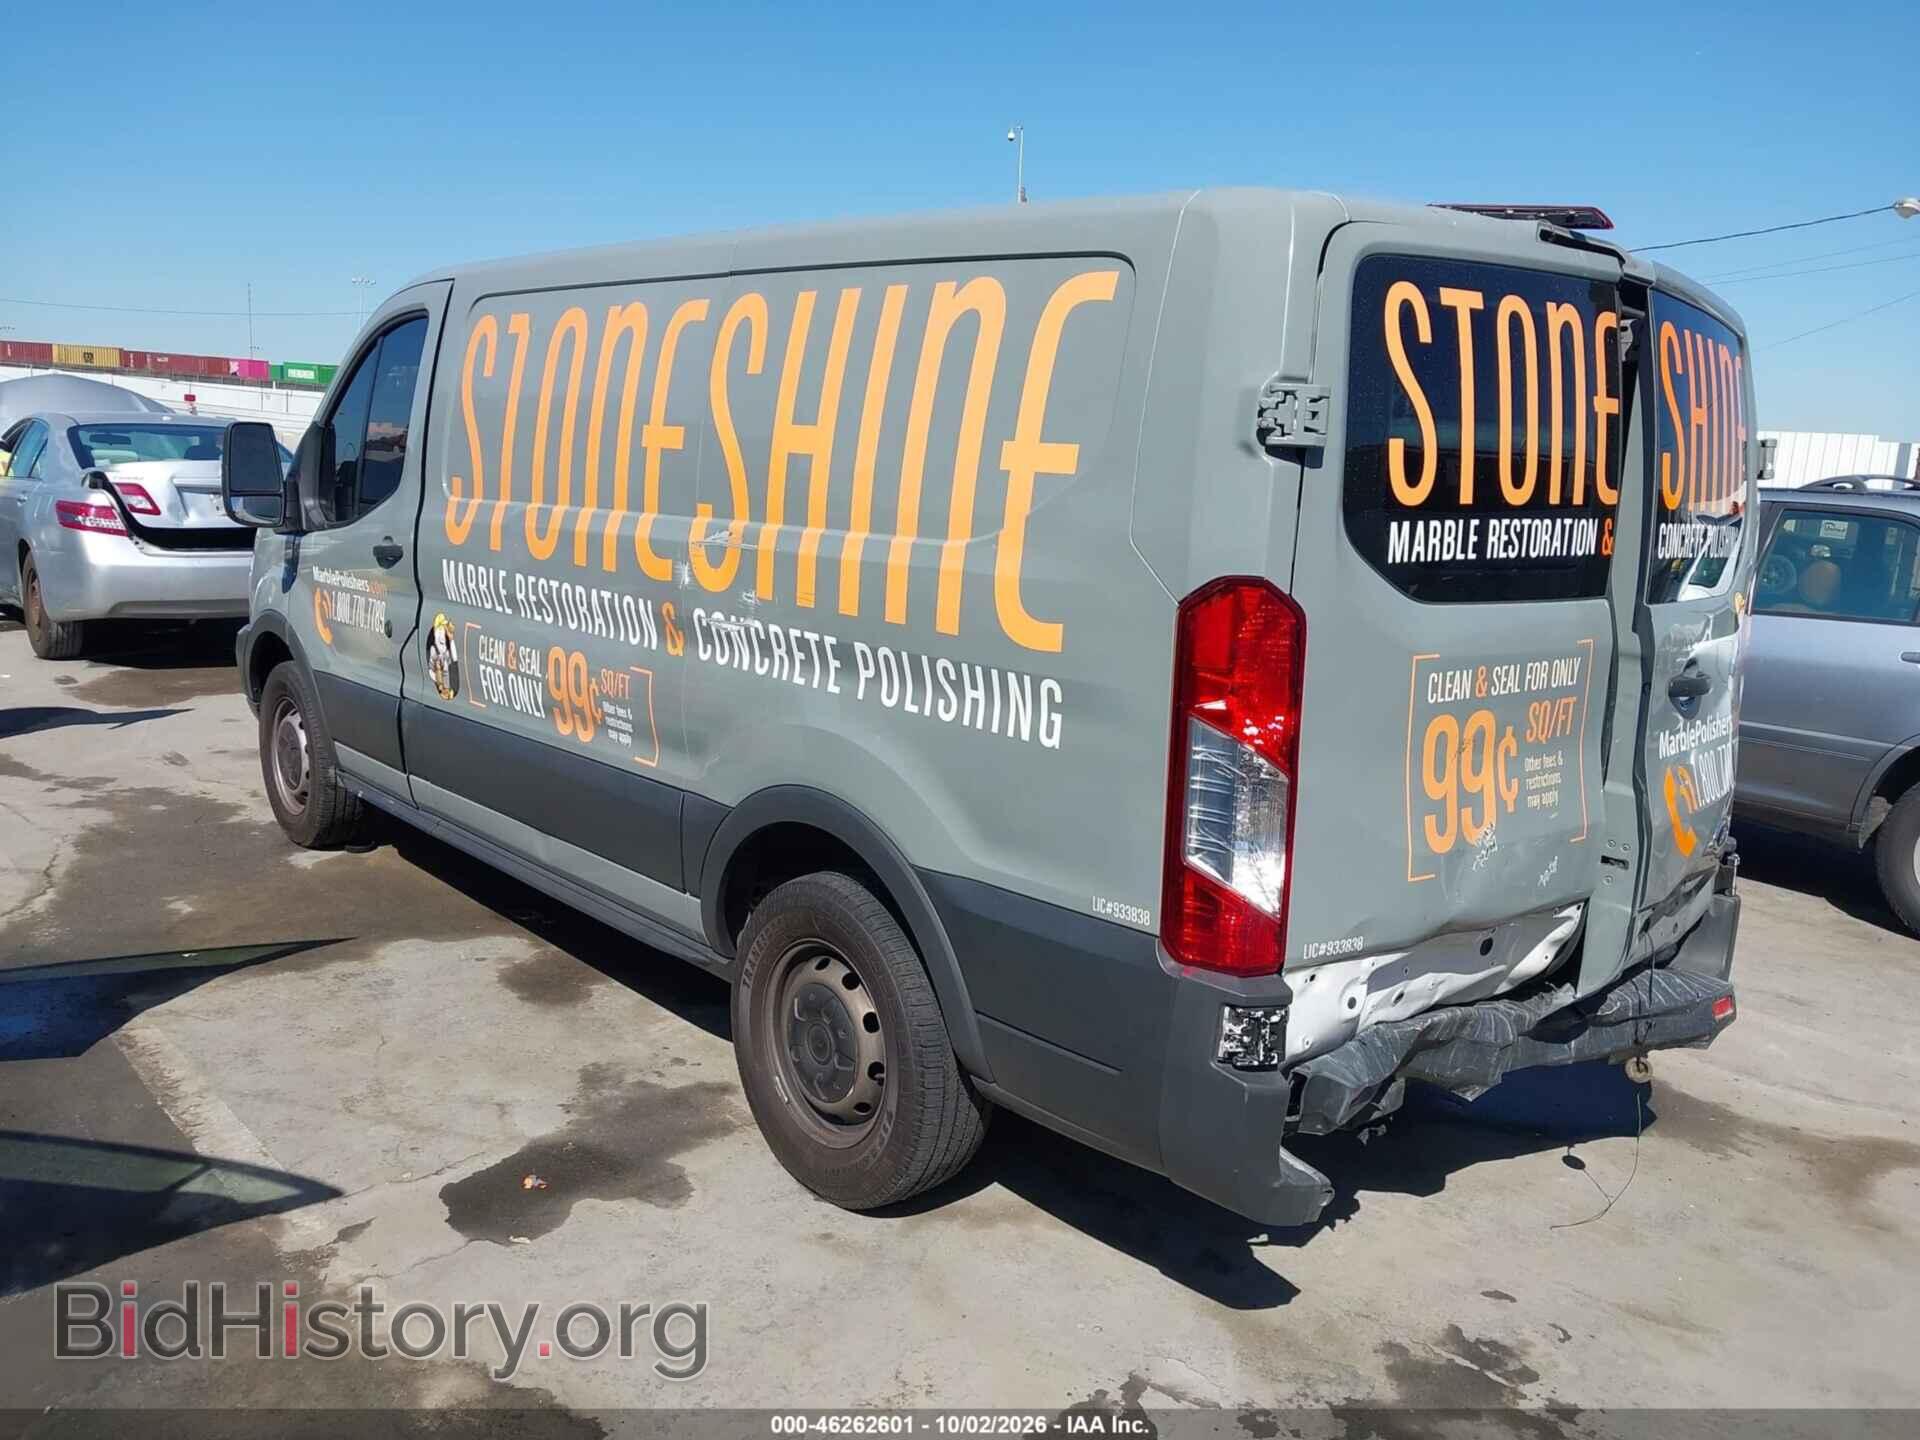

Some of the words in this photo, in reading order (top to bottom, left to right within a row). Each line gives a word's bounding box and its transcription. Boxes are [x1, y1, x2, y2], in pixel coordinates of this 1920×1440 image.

[1388, 518, 1478, 564] MARBLE
[1487, 517, 1599, 560] RESTORATION
[1601, 516, 1613, 556] &
[442, 558, 513, 615] MARBLE
[515, 573, 658, 650] RESTORATION
[661, 602, 684, 657] &
[692, 607, 841, 694] CONCRETE
[853, 641, 1063, 750] POLISHING
[478, 634, 506, 668] CLEAN
[507, 640, 518, 672] &
[518, 646, 542, 678] SEAL
[479, 664, 509, 707] FOR
[507, 673, 546, 719] ONLY
[600, 668, 631, 700] SQ/FT
[1427, 669, 1473, 704] CLEAN
[1475, 665, 1488, 698] &
[1491, 664, 1521, 696] SEAL
[1525, 660, 1549, 691] FOR
[1551, 656, 1582, 688] ONLY
[1525, 696, 1577, 743] SQ/FT
[1092, 895, 1150, 926] LIC#933838
[1303, 936, 1364, 960] LIC#933838
